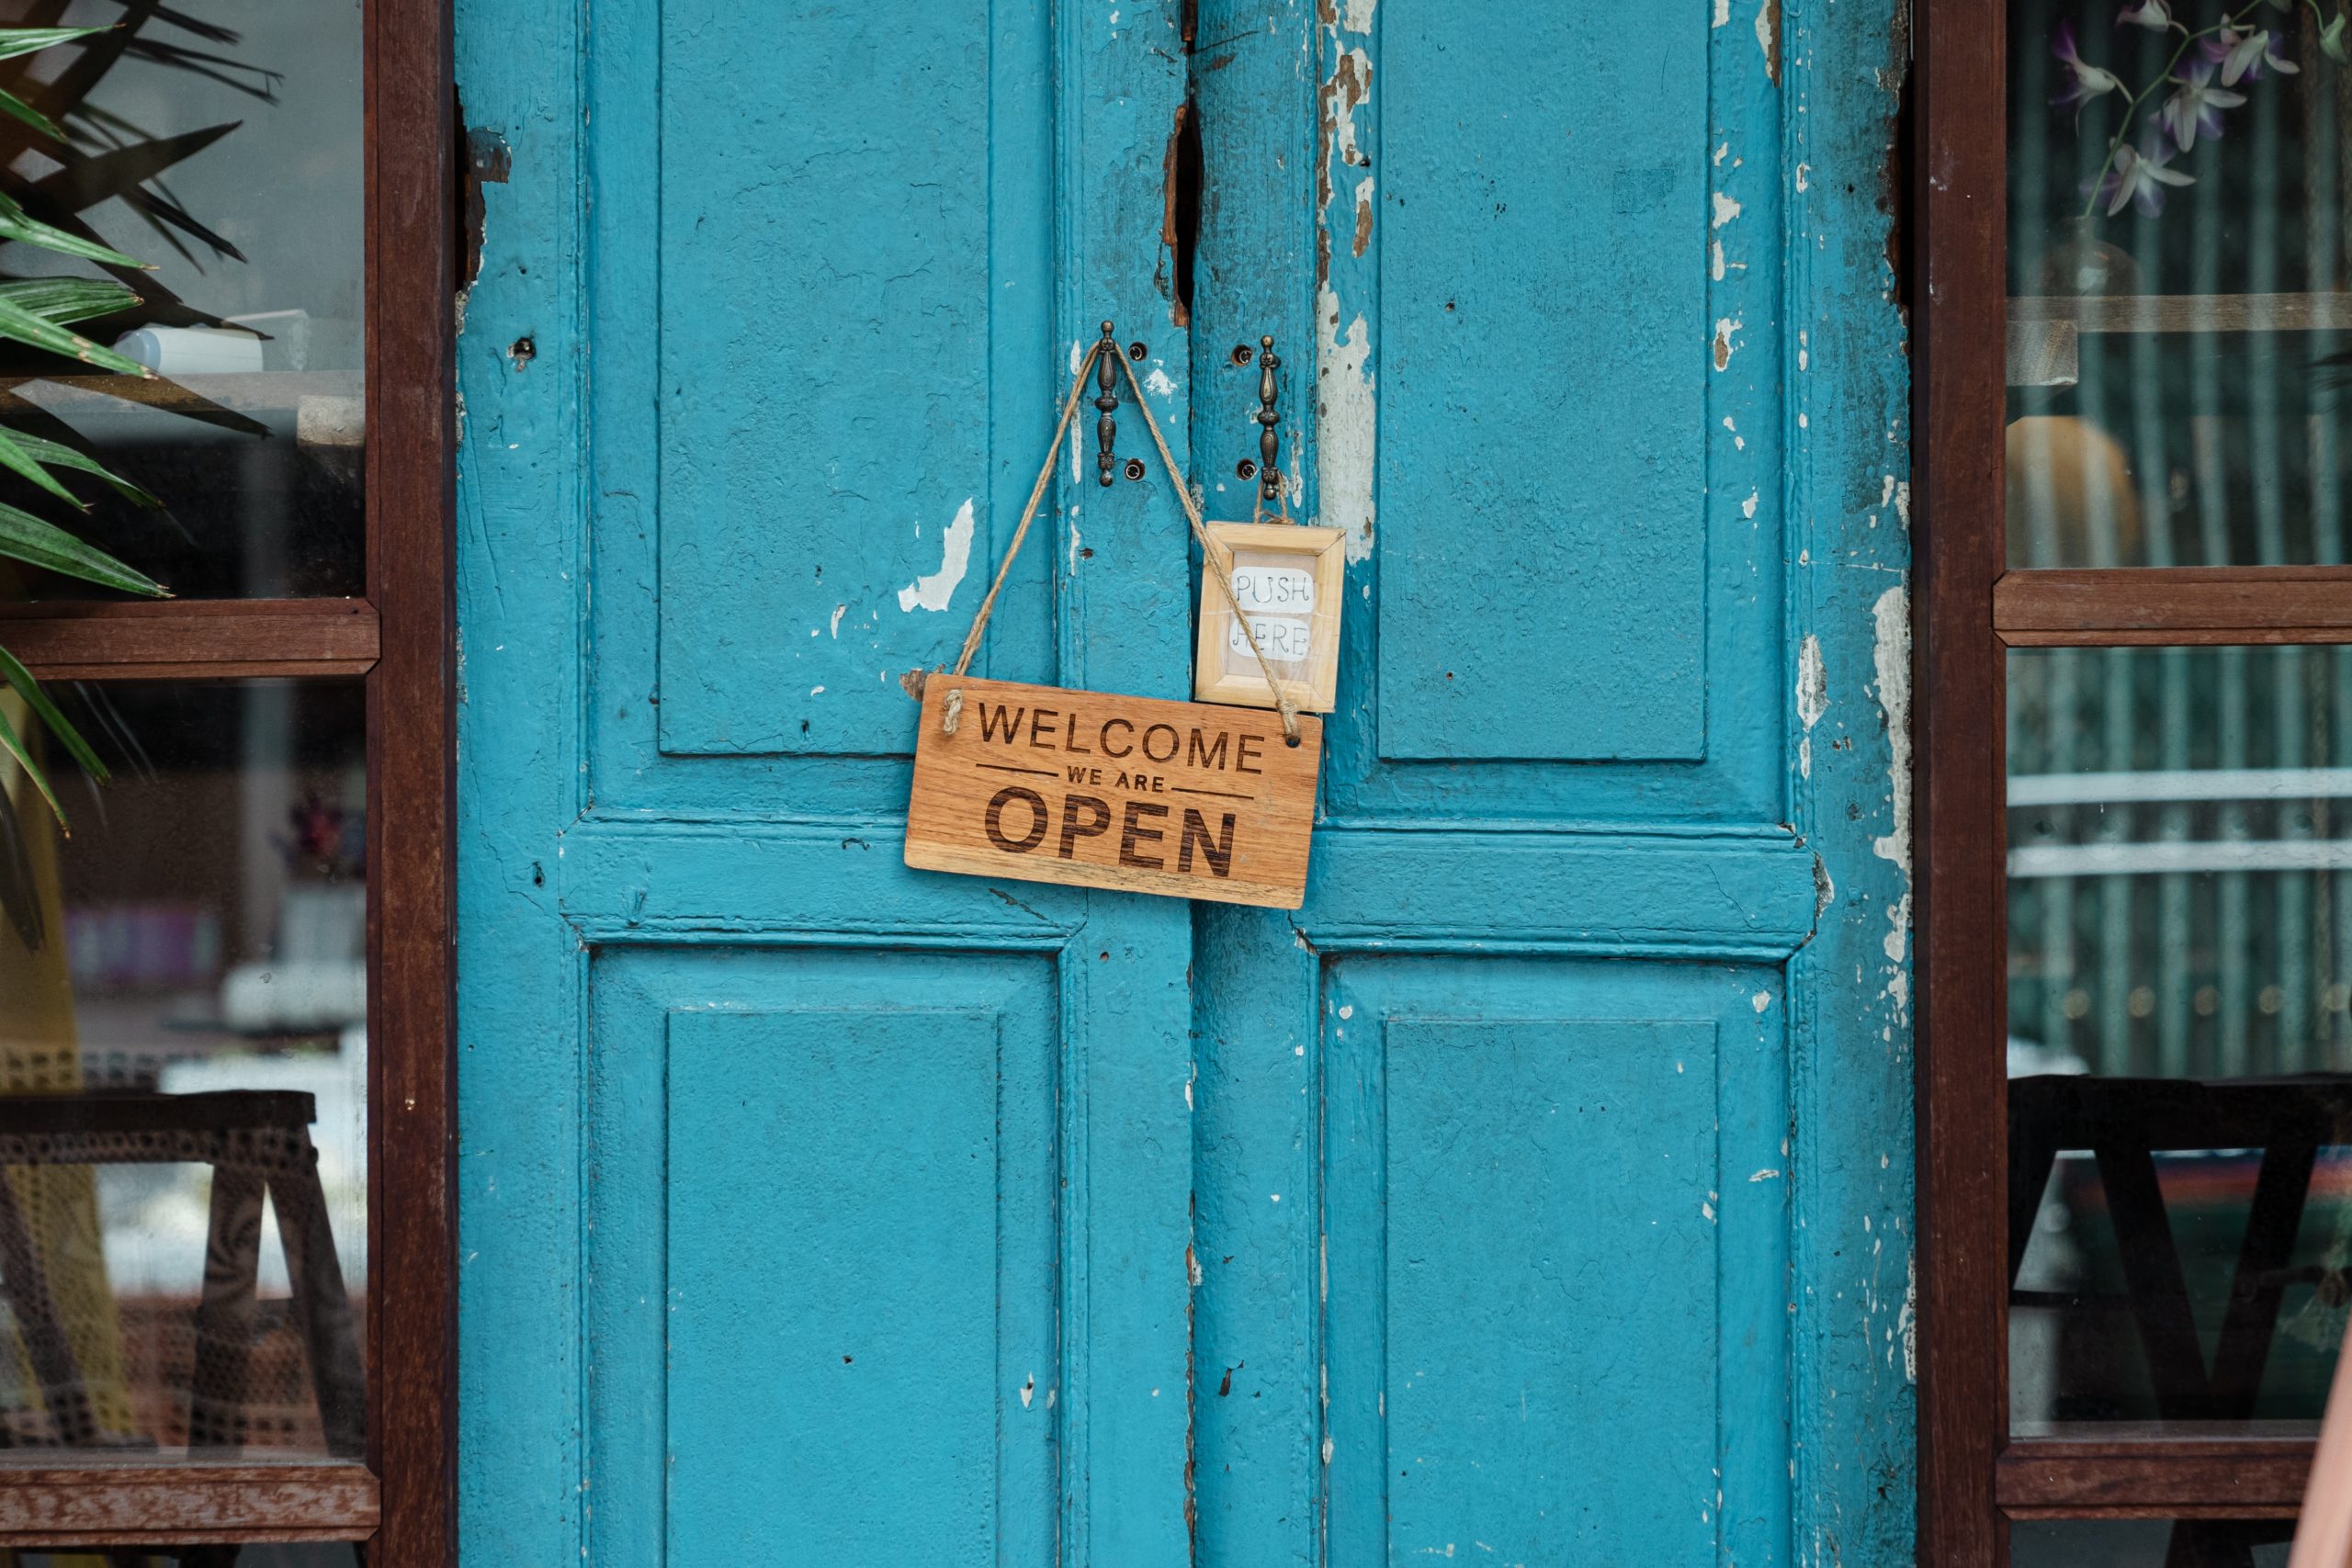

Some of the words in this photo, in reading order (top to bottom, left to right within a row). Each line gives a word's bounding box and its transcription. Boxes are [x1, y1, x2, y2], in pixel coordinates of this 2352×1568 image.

[1237, 575, 1309, 603] PUSH
[978, 702, 1265, 774] WELCOME
[1067, 765, 1102, 785] WE
[1115, 772, 1164, 793] ARE
[984, 786, 1236, 877] OPEN
